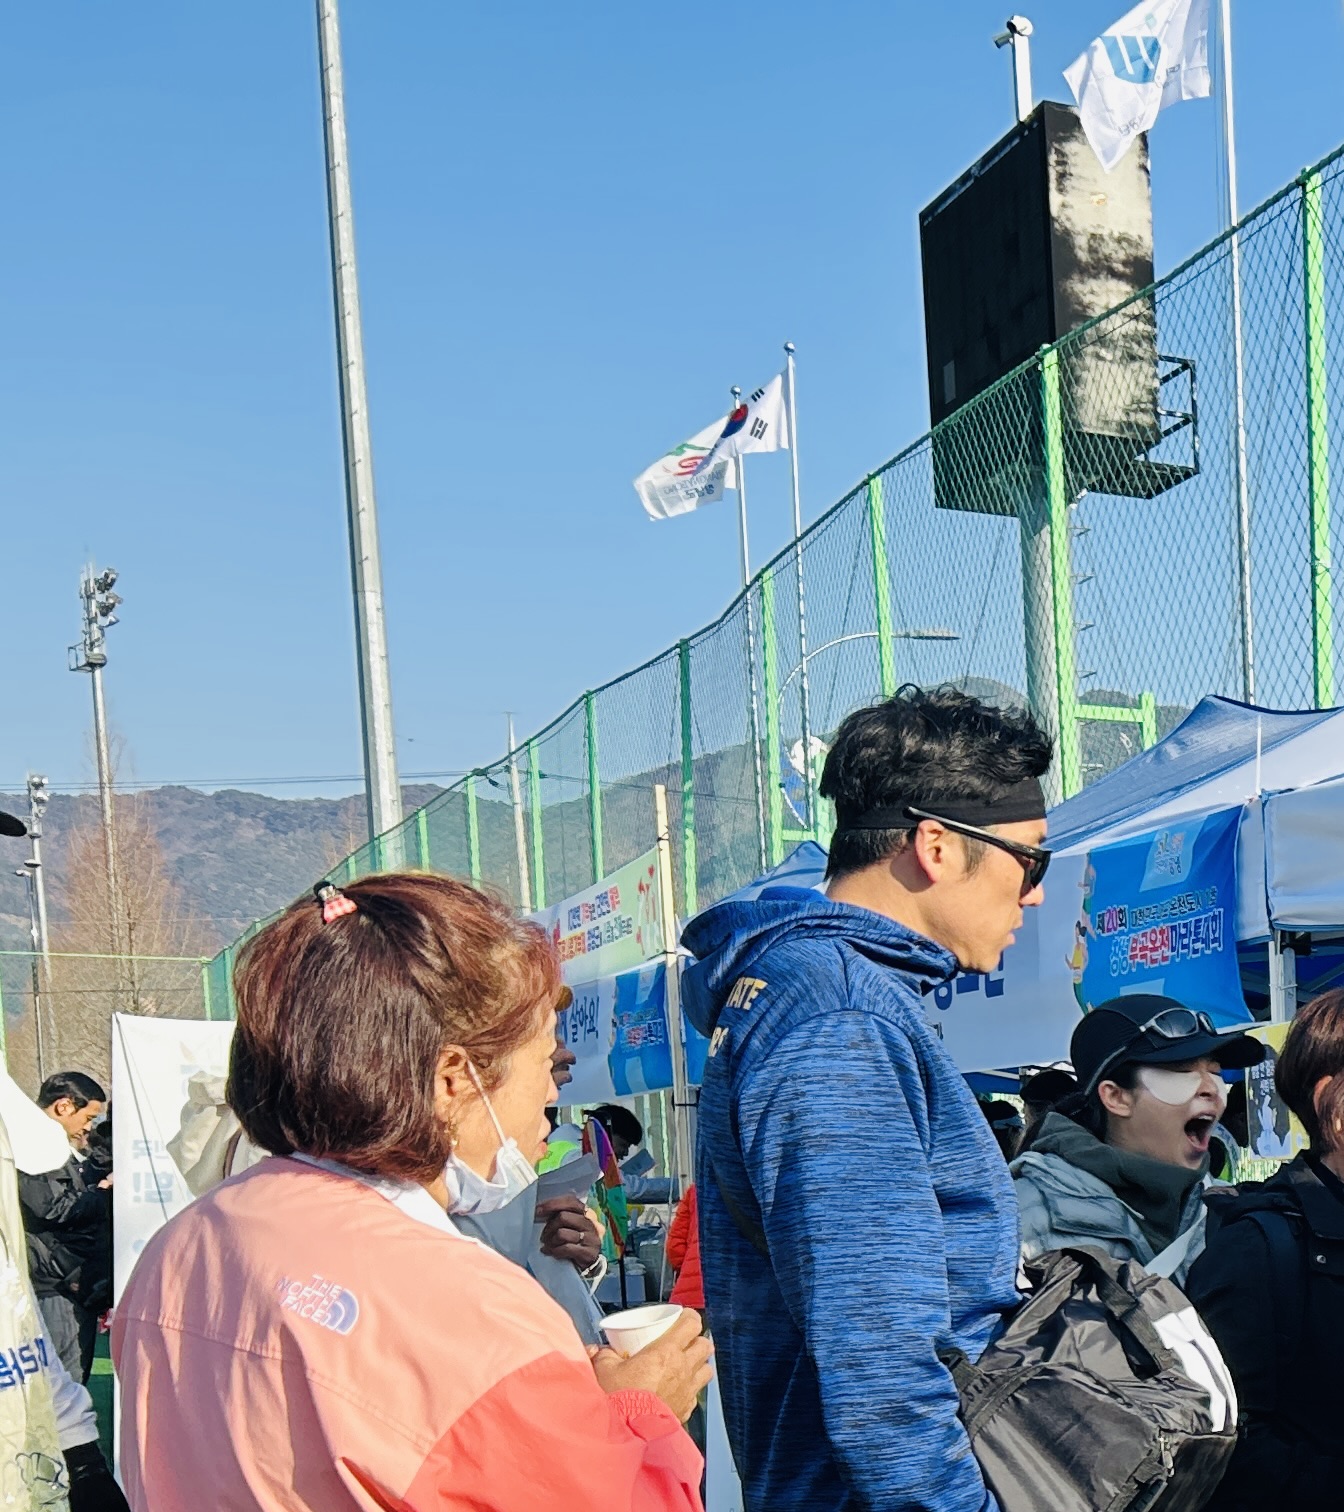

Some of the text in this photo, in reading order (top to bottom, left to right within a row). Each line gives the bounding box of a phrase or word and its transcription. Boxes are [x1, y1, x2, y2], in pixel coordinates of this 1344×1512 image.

[277, 1276, 335, 1311] NORTH
[312, 1273, 342, 1299] THE
[280, 1295, 329, 1325] FACE
